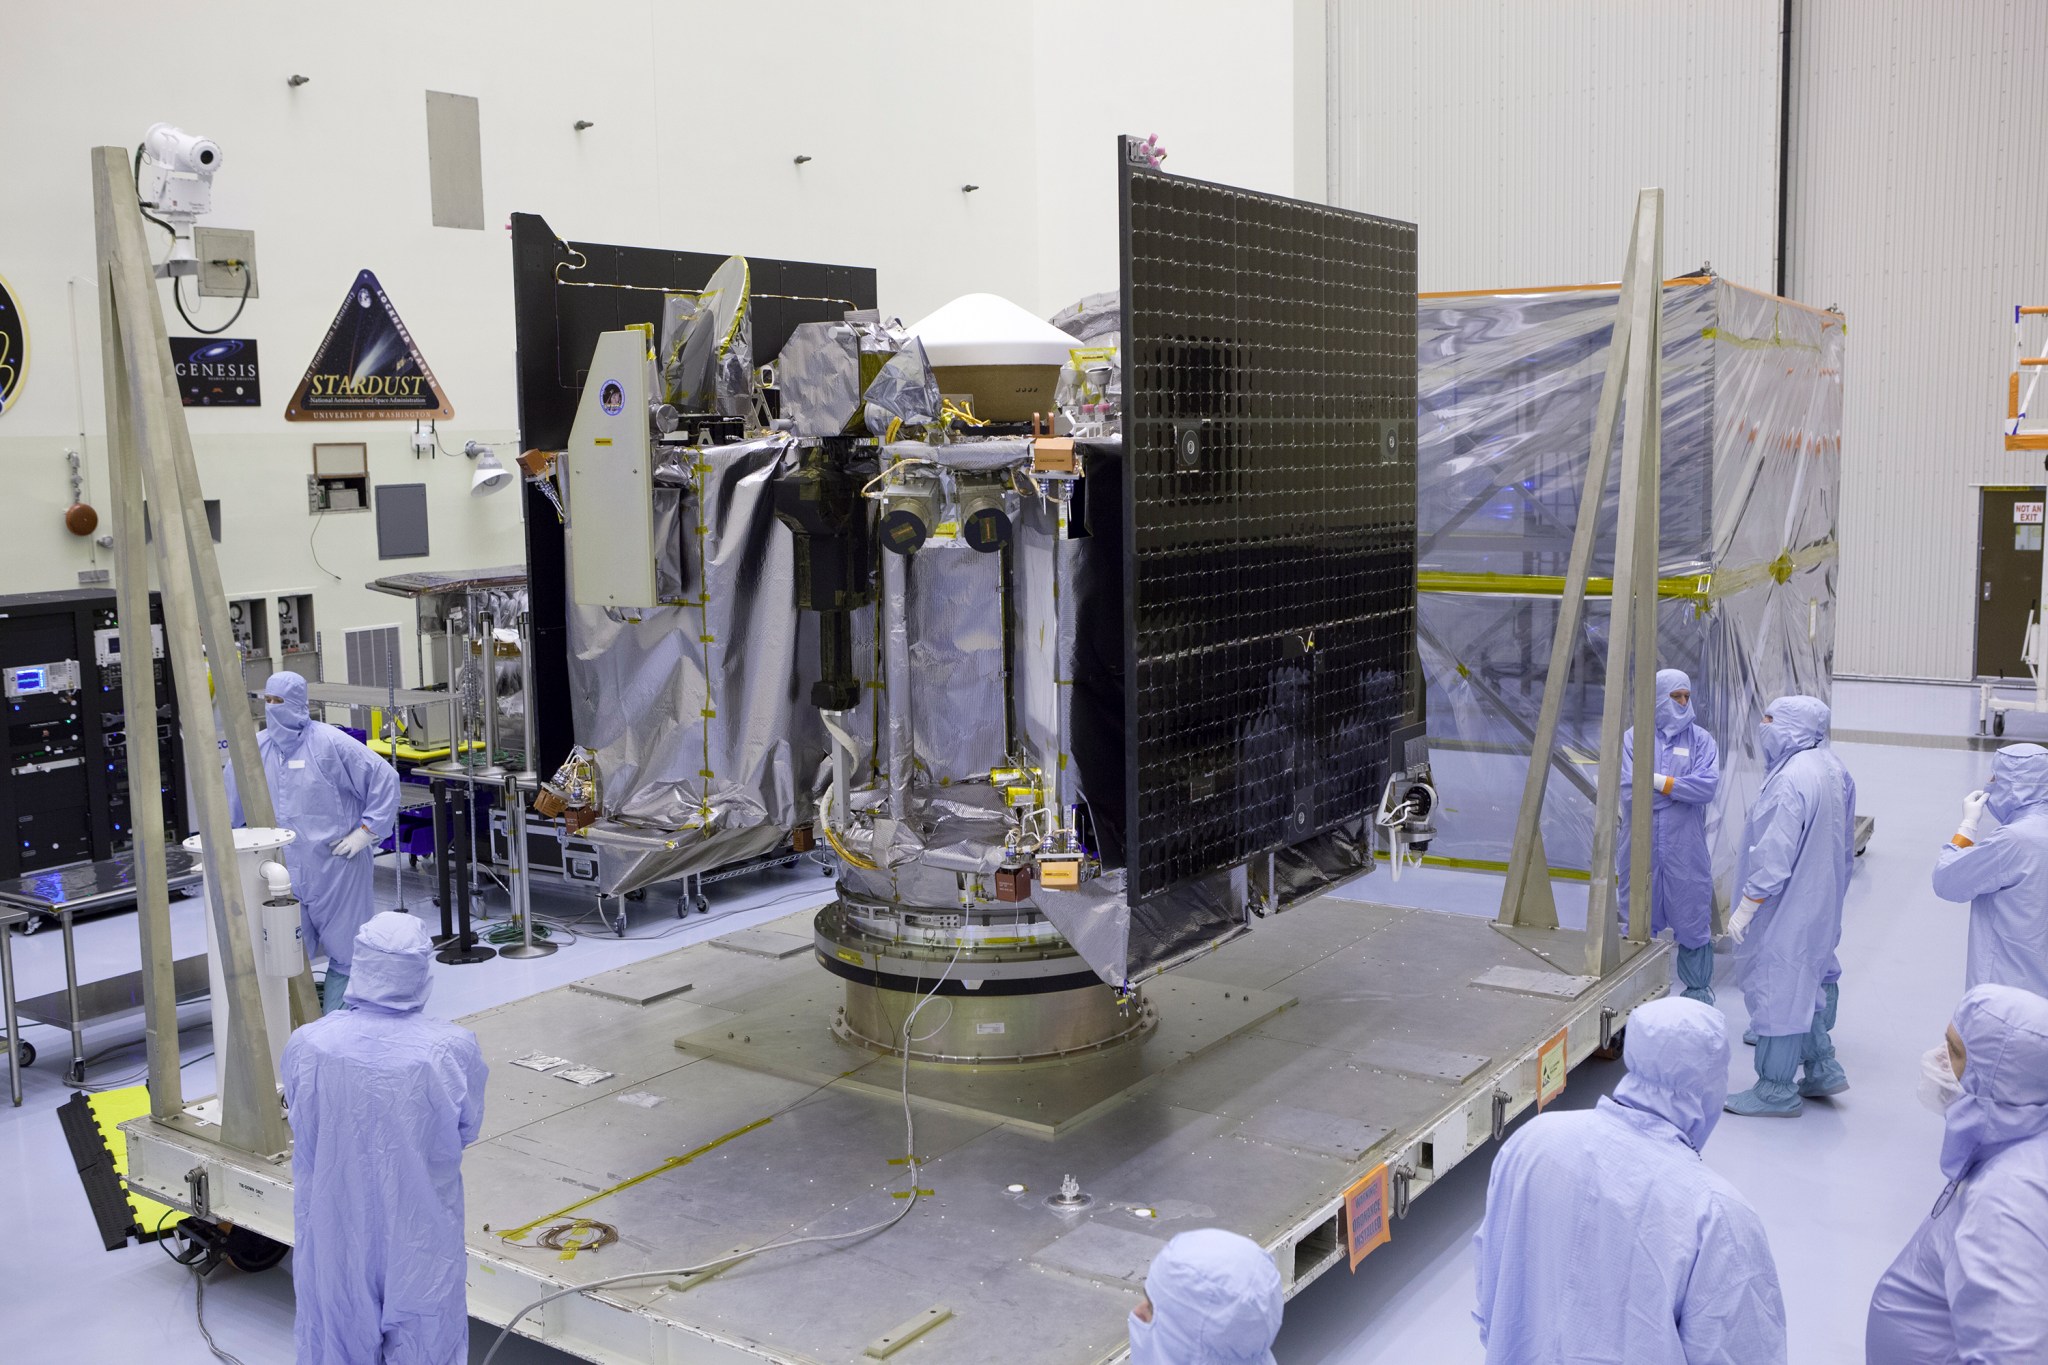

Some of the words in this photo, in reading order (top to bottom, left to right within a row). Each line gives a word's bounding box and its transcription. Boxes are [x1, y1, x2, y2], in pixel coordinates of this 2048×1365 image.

[303, 369, 313, 382] Jet
[311, 331, 334, 370] Propulsion
[332, 292, 356, 330] Laboratory
[376, 289, 410, 346] LOCKHEED
[411, 349, 437, 388] MARTIN
[175, 362, 256, 377] GENESIS
[310, 374, 425, 395] STARDUST
[313, 411, 363, 419] UNIVERSITY
[2015, 505, 2030, 513] NOT
[2032, 505, 2042, 513] AN
[2020, 513, 2038, 521] EXIT
[1354, 1215, 1382, 1250] INSTALLED
